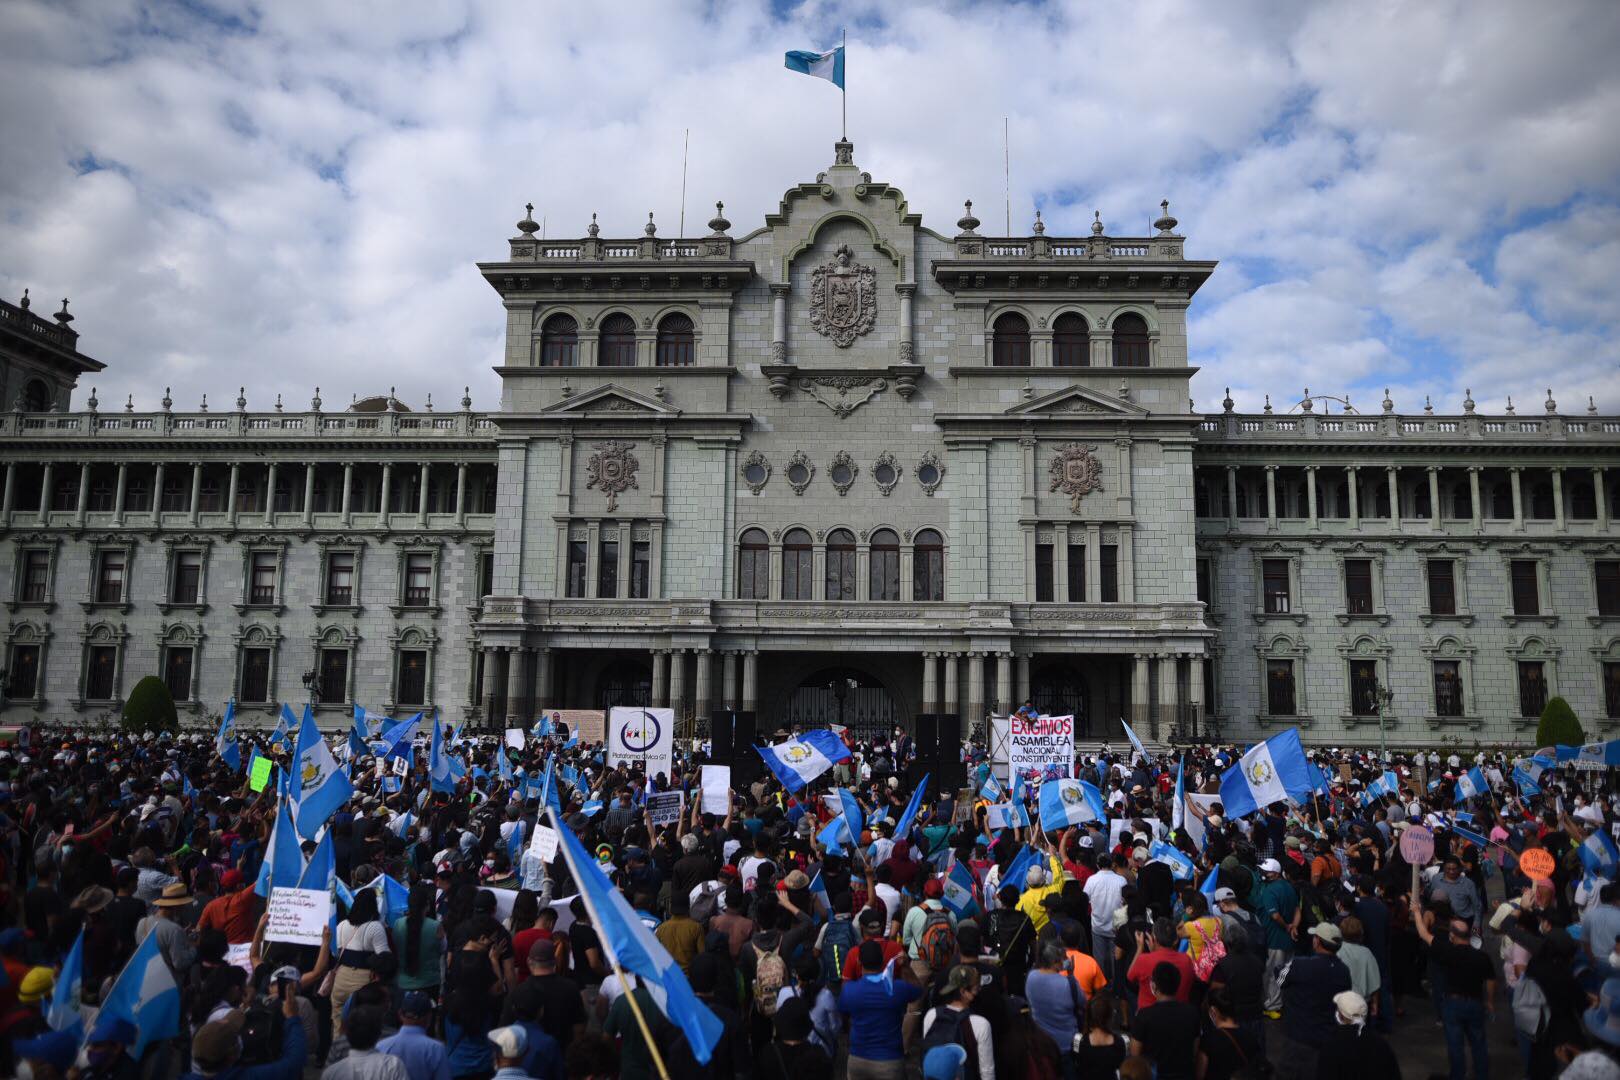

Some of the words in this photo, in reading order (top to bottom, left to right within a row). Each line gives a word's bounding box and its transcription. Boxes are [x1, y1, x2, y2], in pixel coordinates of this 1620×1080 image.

[1011, 718, 1072, 735] EXIGIMOS
[1012, 736, 1071, 746] ASAMBLEA
[1022, 747, 1061, 755] NACIONAL
[612, 752, 640, 760] Plataforma
[1011, 754, 1072, 763] CONSTITUYENTE
